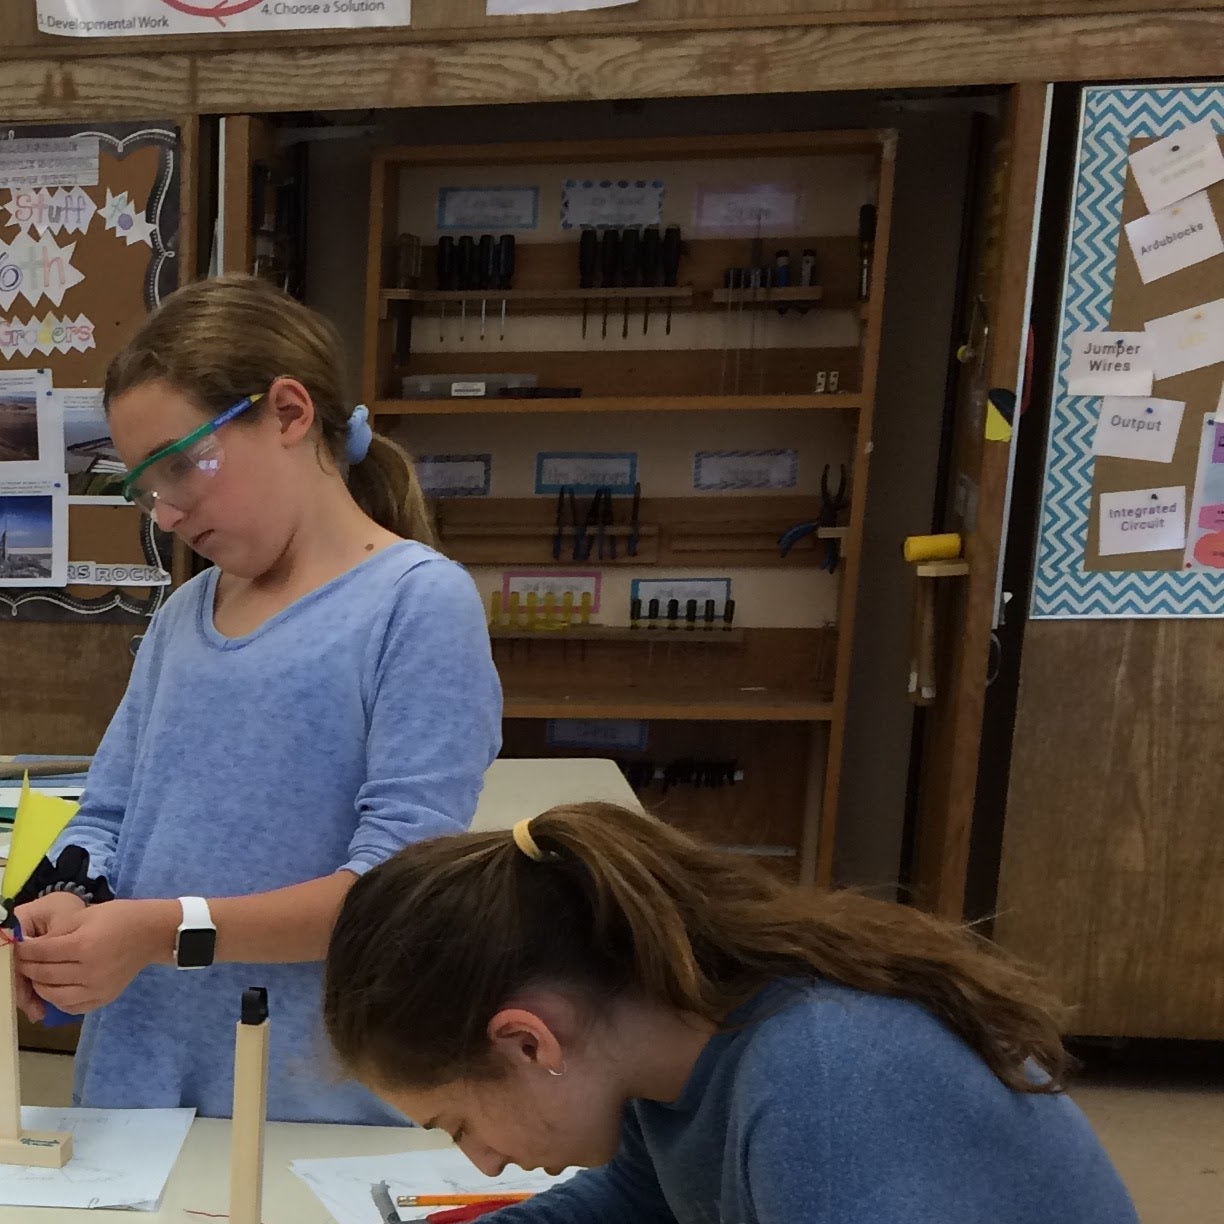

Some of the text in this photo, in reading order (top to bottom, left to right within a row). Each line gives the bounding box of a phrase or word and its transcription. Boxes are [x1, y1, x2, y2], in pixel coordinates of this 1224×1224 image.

[261, 0, 386, 15] 4. Choose a Solution
[47, 15, 136, 32] Developmental
[138, 16, 170, 29] Work
[15, 194, 89, 224] Stuff
[1141, 223, 1204, 255] Ardublocks
[1084, 343, 1141, 357] Jumper
[1089, 359, 1131, 372] Wires
[1111, 414, 1162, 432] Output
[1109, 502, 1177, 518] Integrated
[1121, 518, 1165, 532] Circuit
